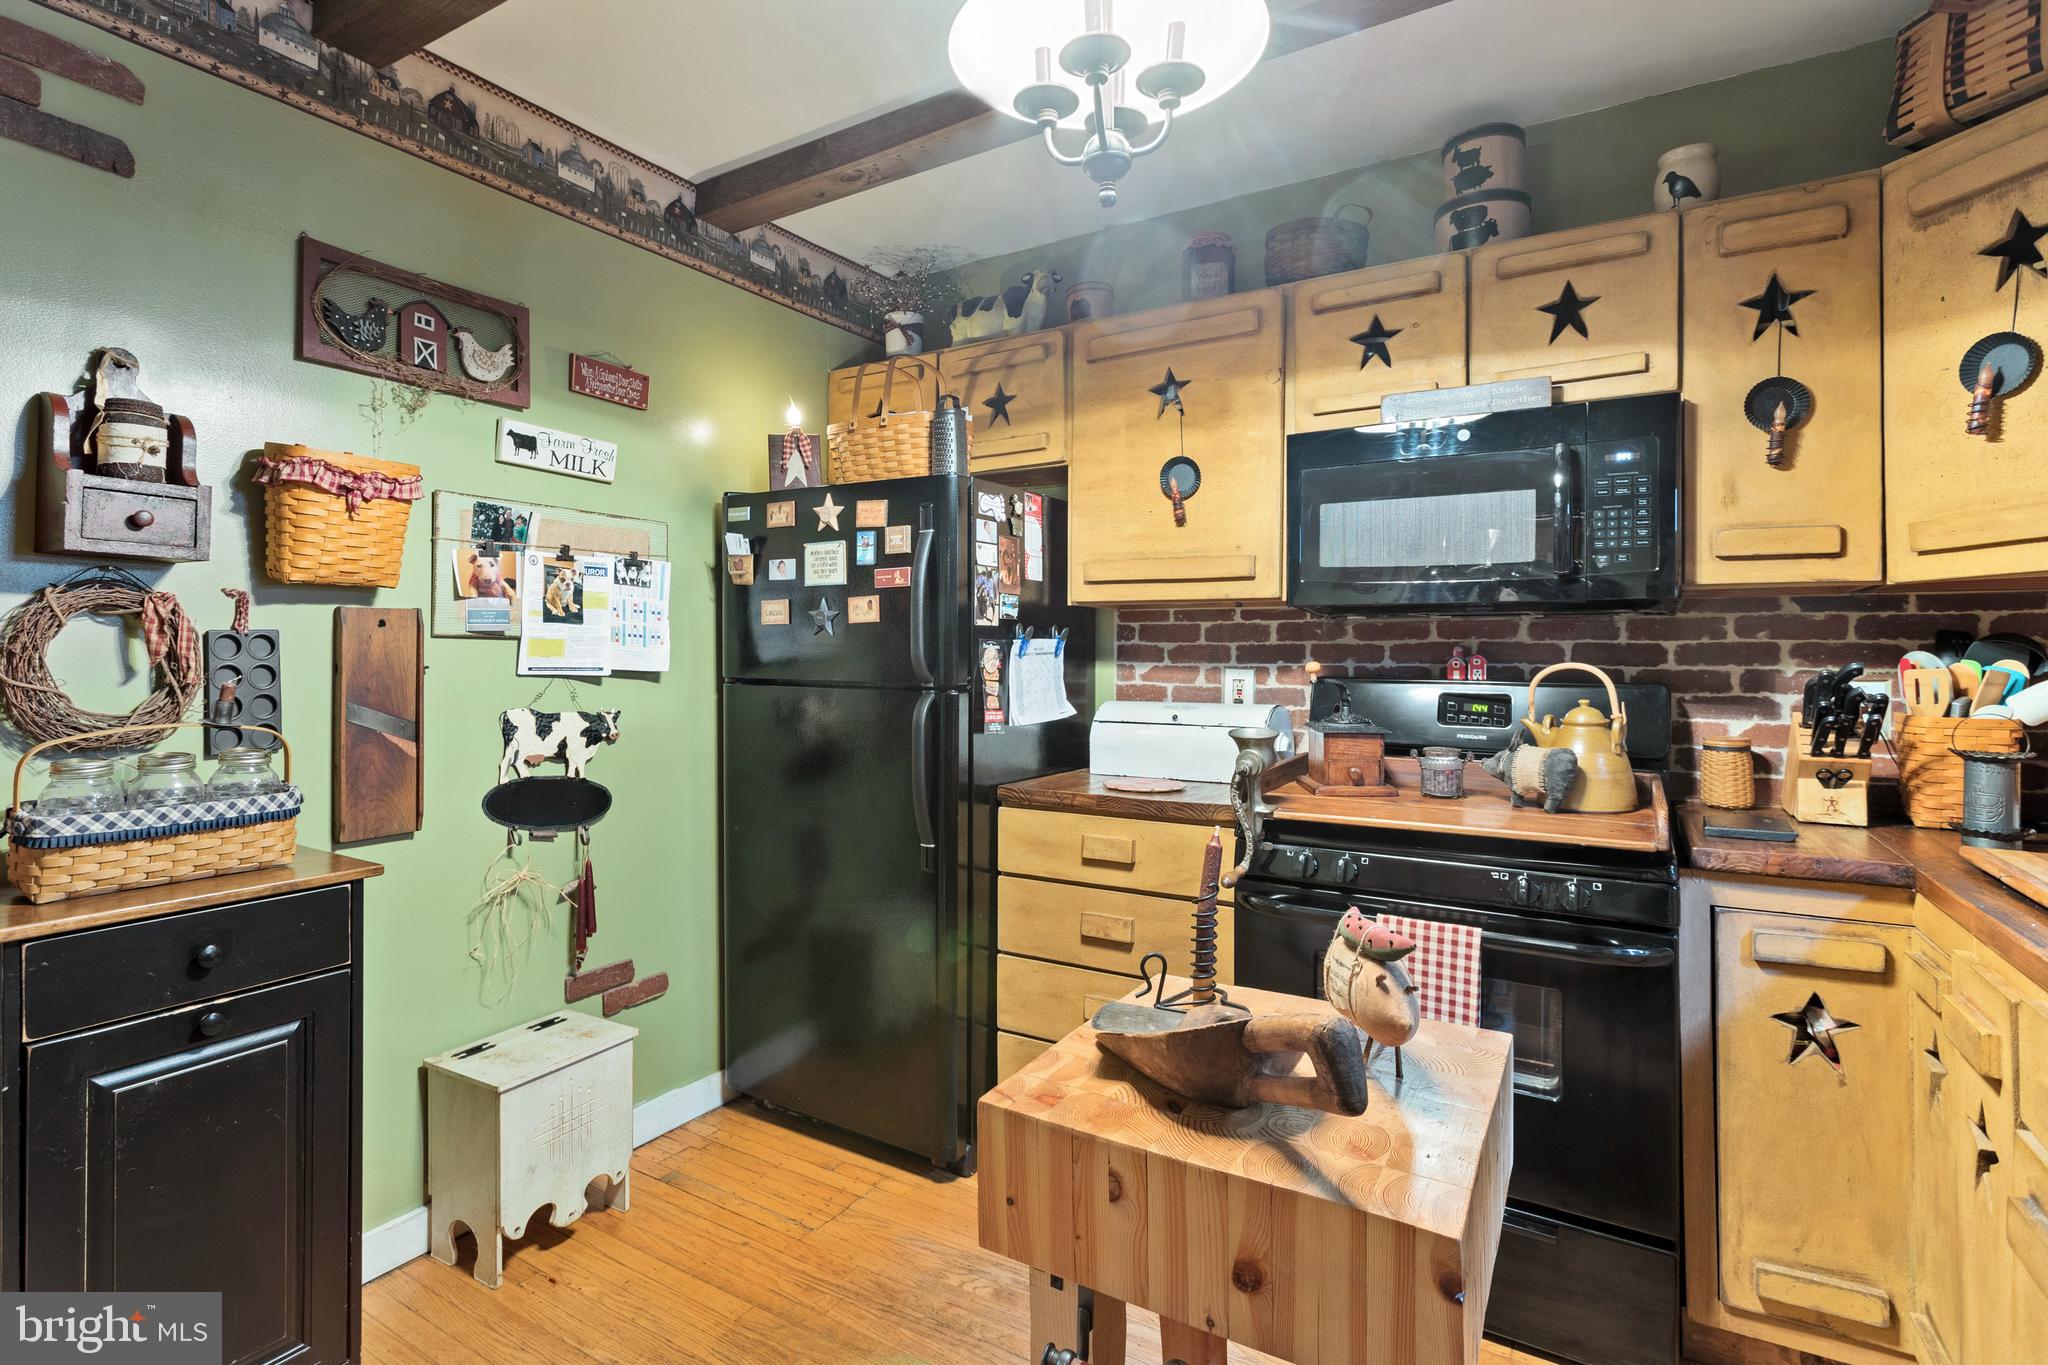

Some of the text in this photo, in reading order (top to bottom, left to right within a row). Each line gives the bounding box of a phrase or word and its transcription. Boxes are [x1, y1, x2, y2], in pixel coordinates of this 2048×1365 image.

[1492, 384, 1527, 395] Made
[1491, 394, 1545, 408] Together
[538, 431, 615, 462] Farm Fresh
[549, 449, 607, 477] MILK
